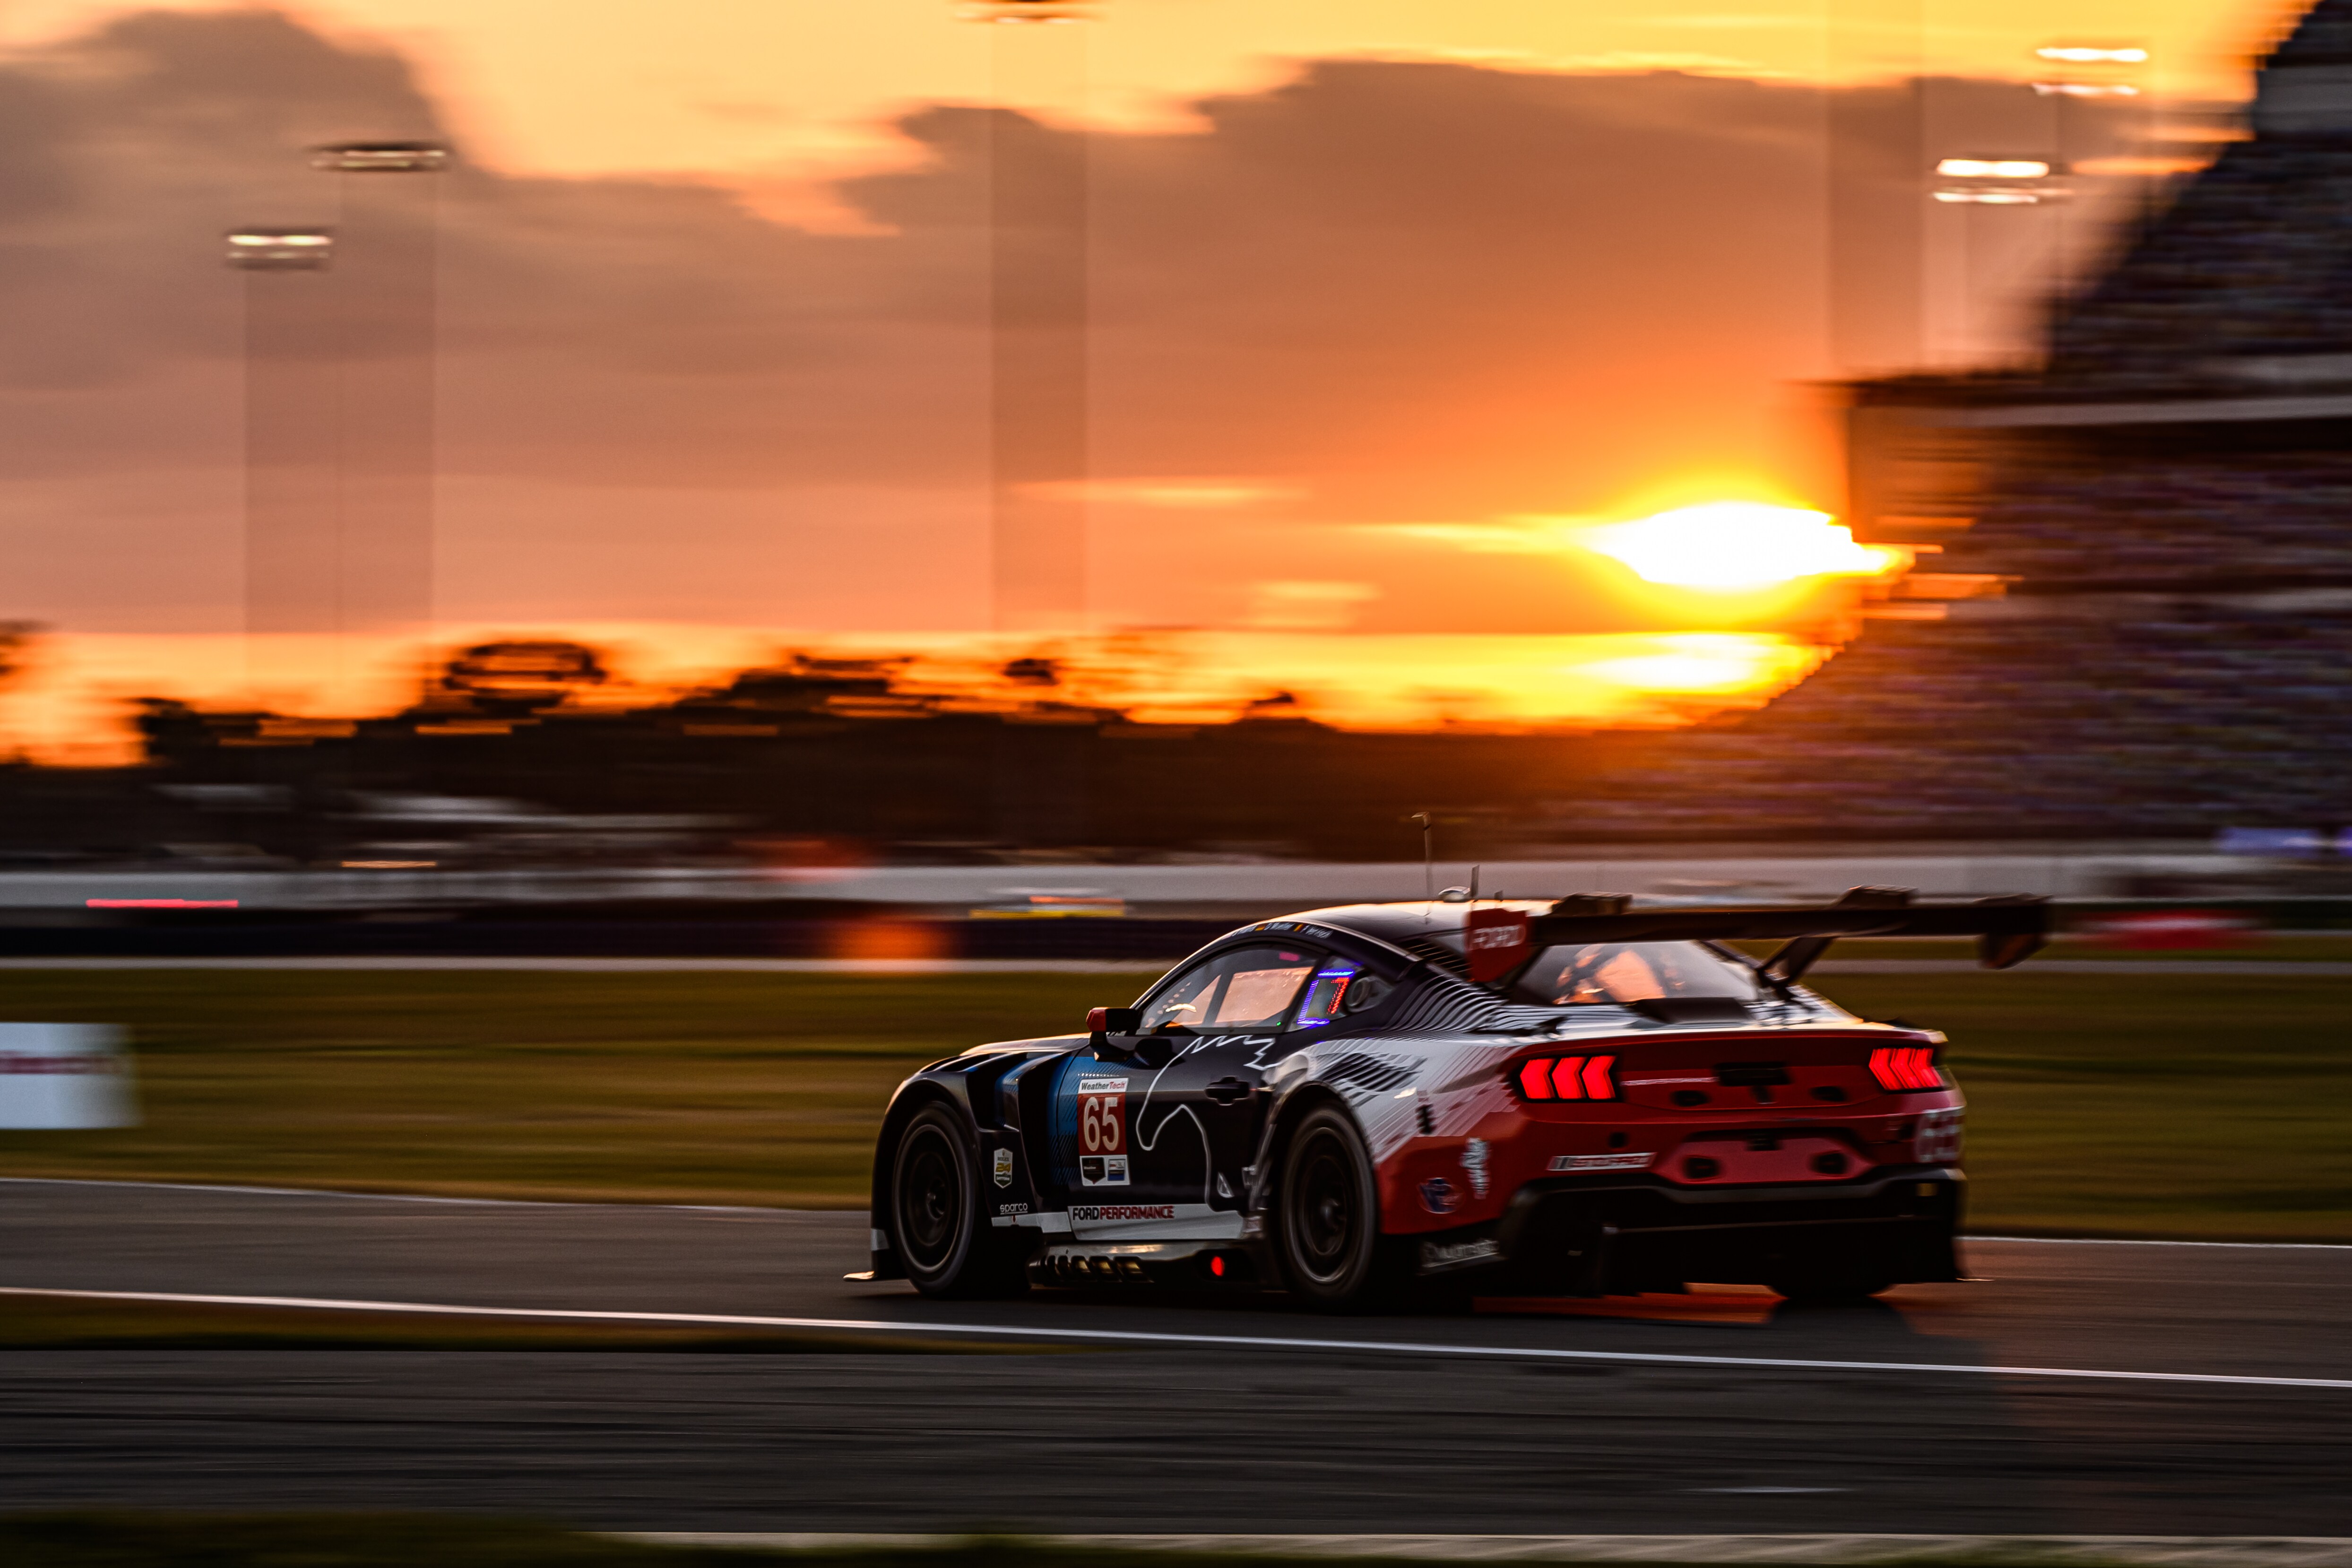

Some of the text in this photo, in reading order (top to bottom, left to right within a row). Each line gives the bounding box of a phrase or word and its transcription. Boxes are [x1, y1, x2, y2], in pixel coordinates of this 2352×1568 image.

[1081, 1081, 1126, 1090] WeatherTech
[1083, 1096, 1120, 1152] 65
[995, 1162, 1012, 1172] 24
[1000, 1203, 1028, 1214] sparco
